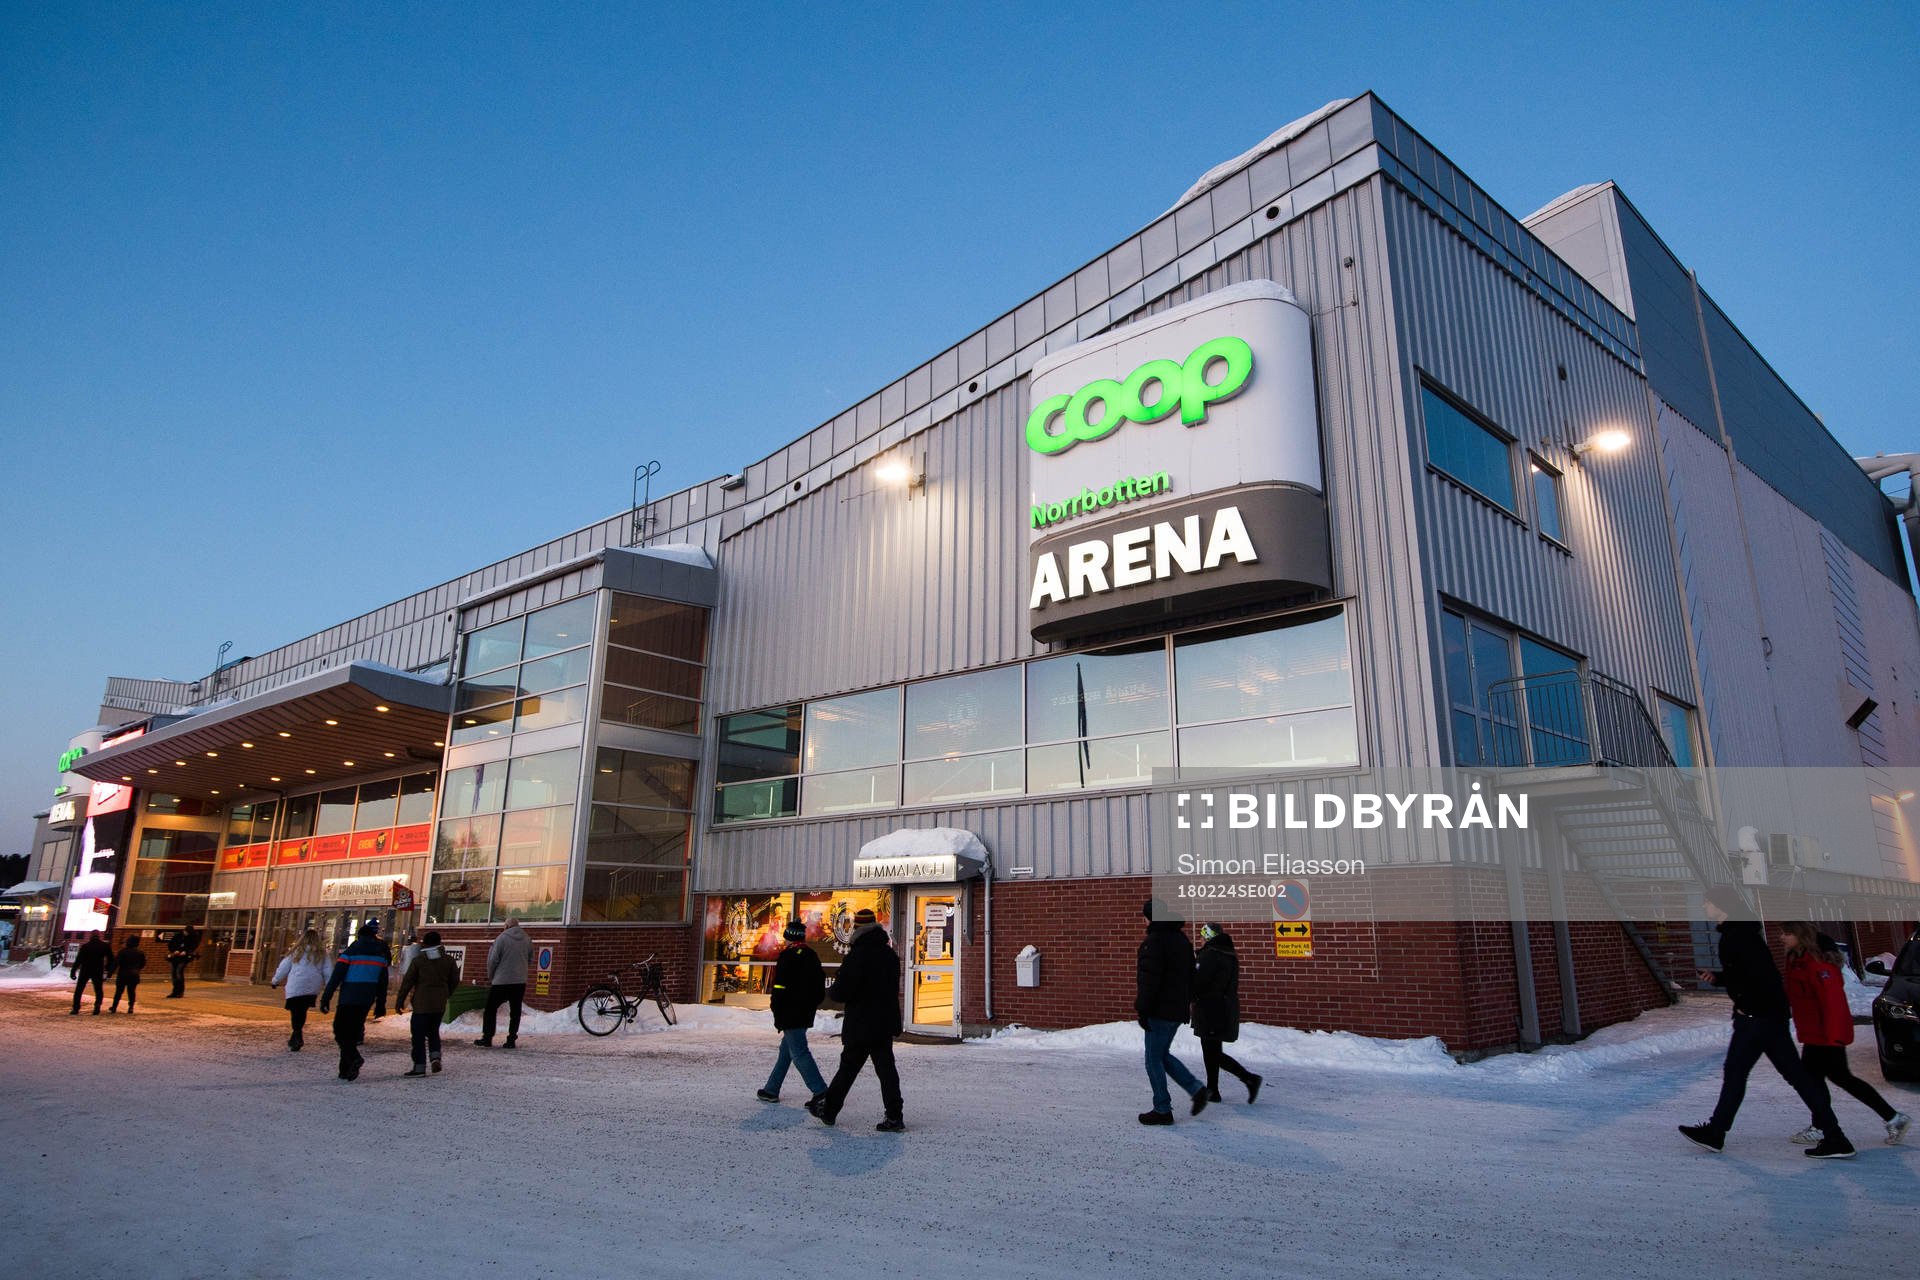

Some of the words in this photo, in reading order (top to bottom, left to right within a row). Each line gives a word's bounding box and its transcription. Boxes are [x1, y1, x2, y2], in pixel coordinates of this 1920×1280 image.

[1026, 336, 1256, 456] coop
[1030, 470, 1172, 529] Norrbotten
[1029, 506, 1258, 610] ARENA
